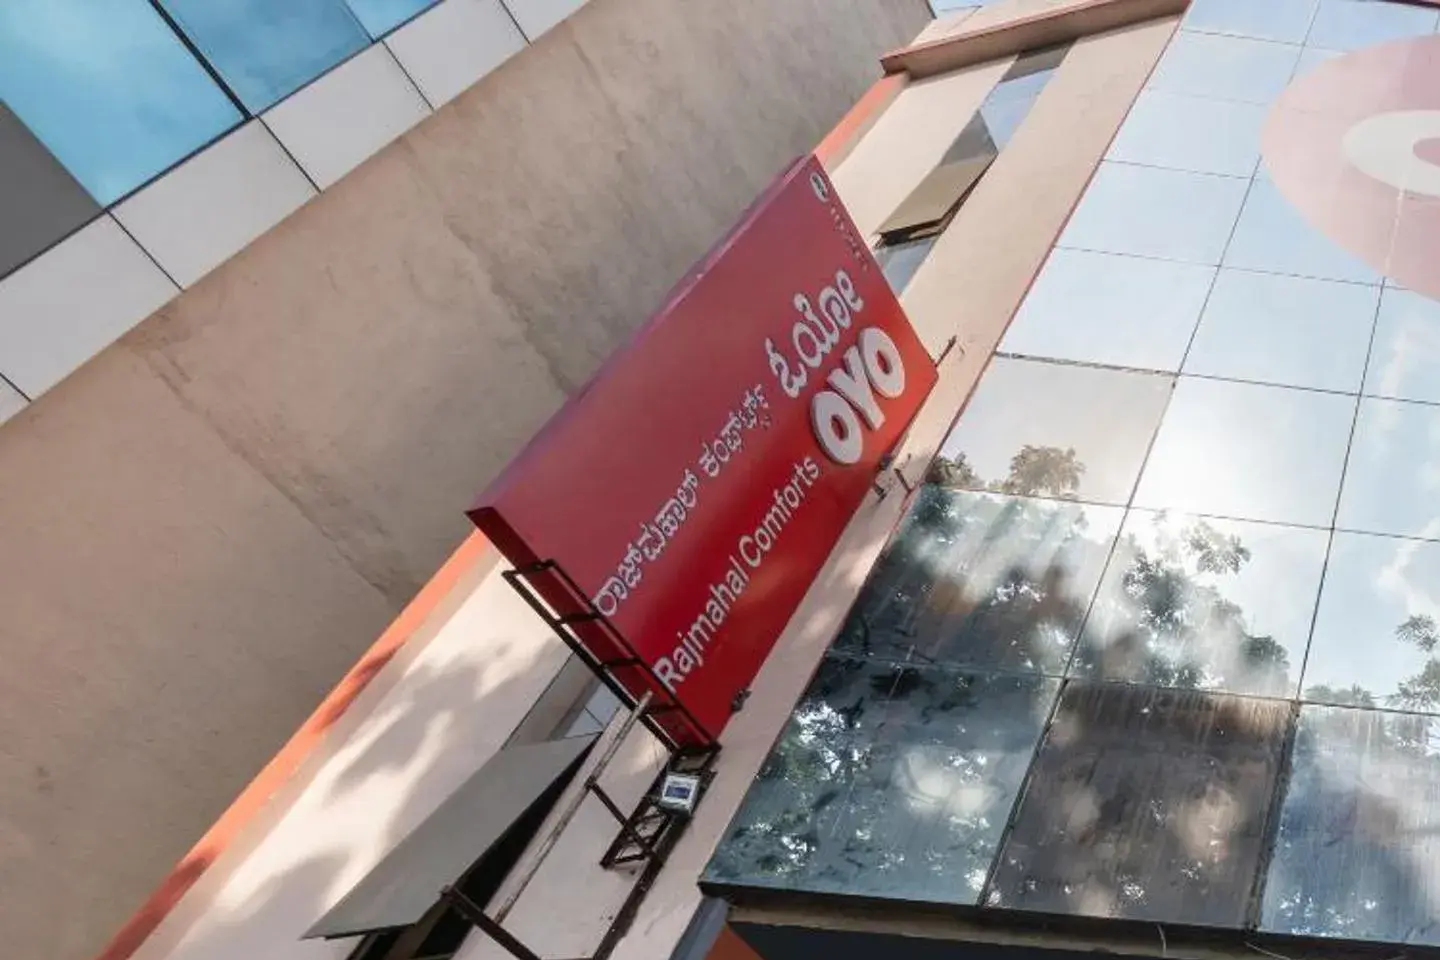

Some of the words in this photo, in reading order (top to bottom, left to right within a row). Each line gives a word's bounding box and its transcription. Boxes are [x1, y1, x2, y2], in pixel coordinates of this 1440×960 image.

[811, 327, 906, 465] OYO
[652, 555, 750, 694] Rajmahal
[738, 455, 819, 568] Comforts
